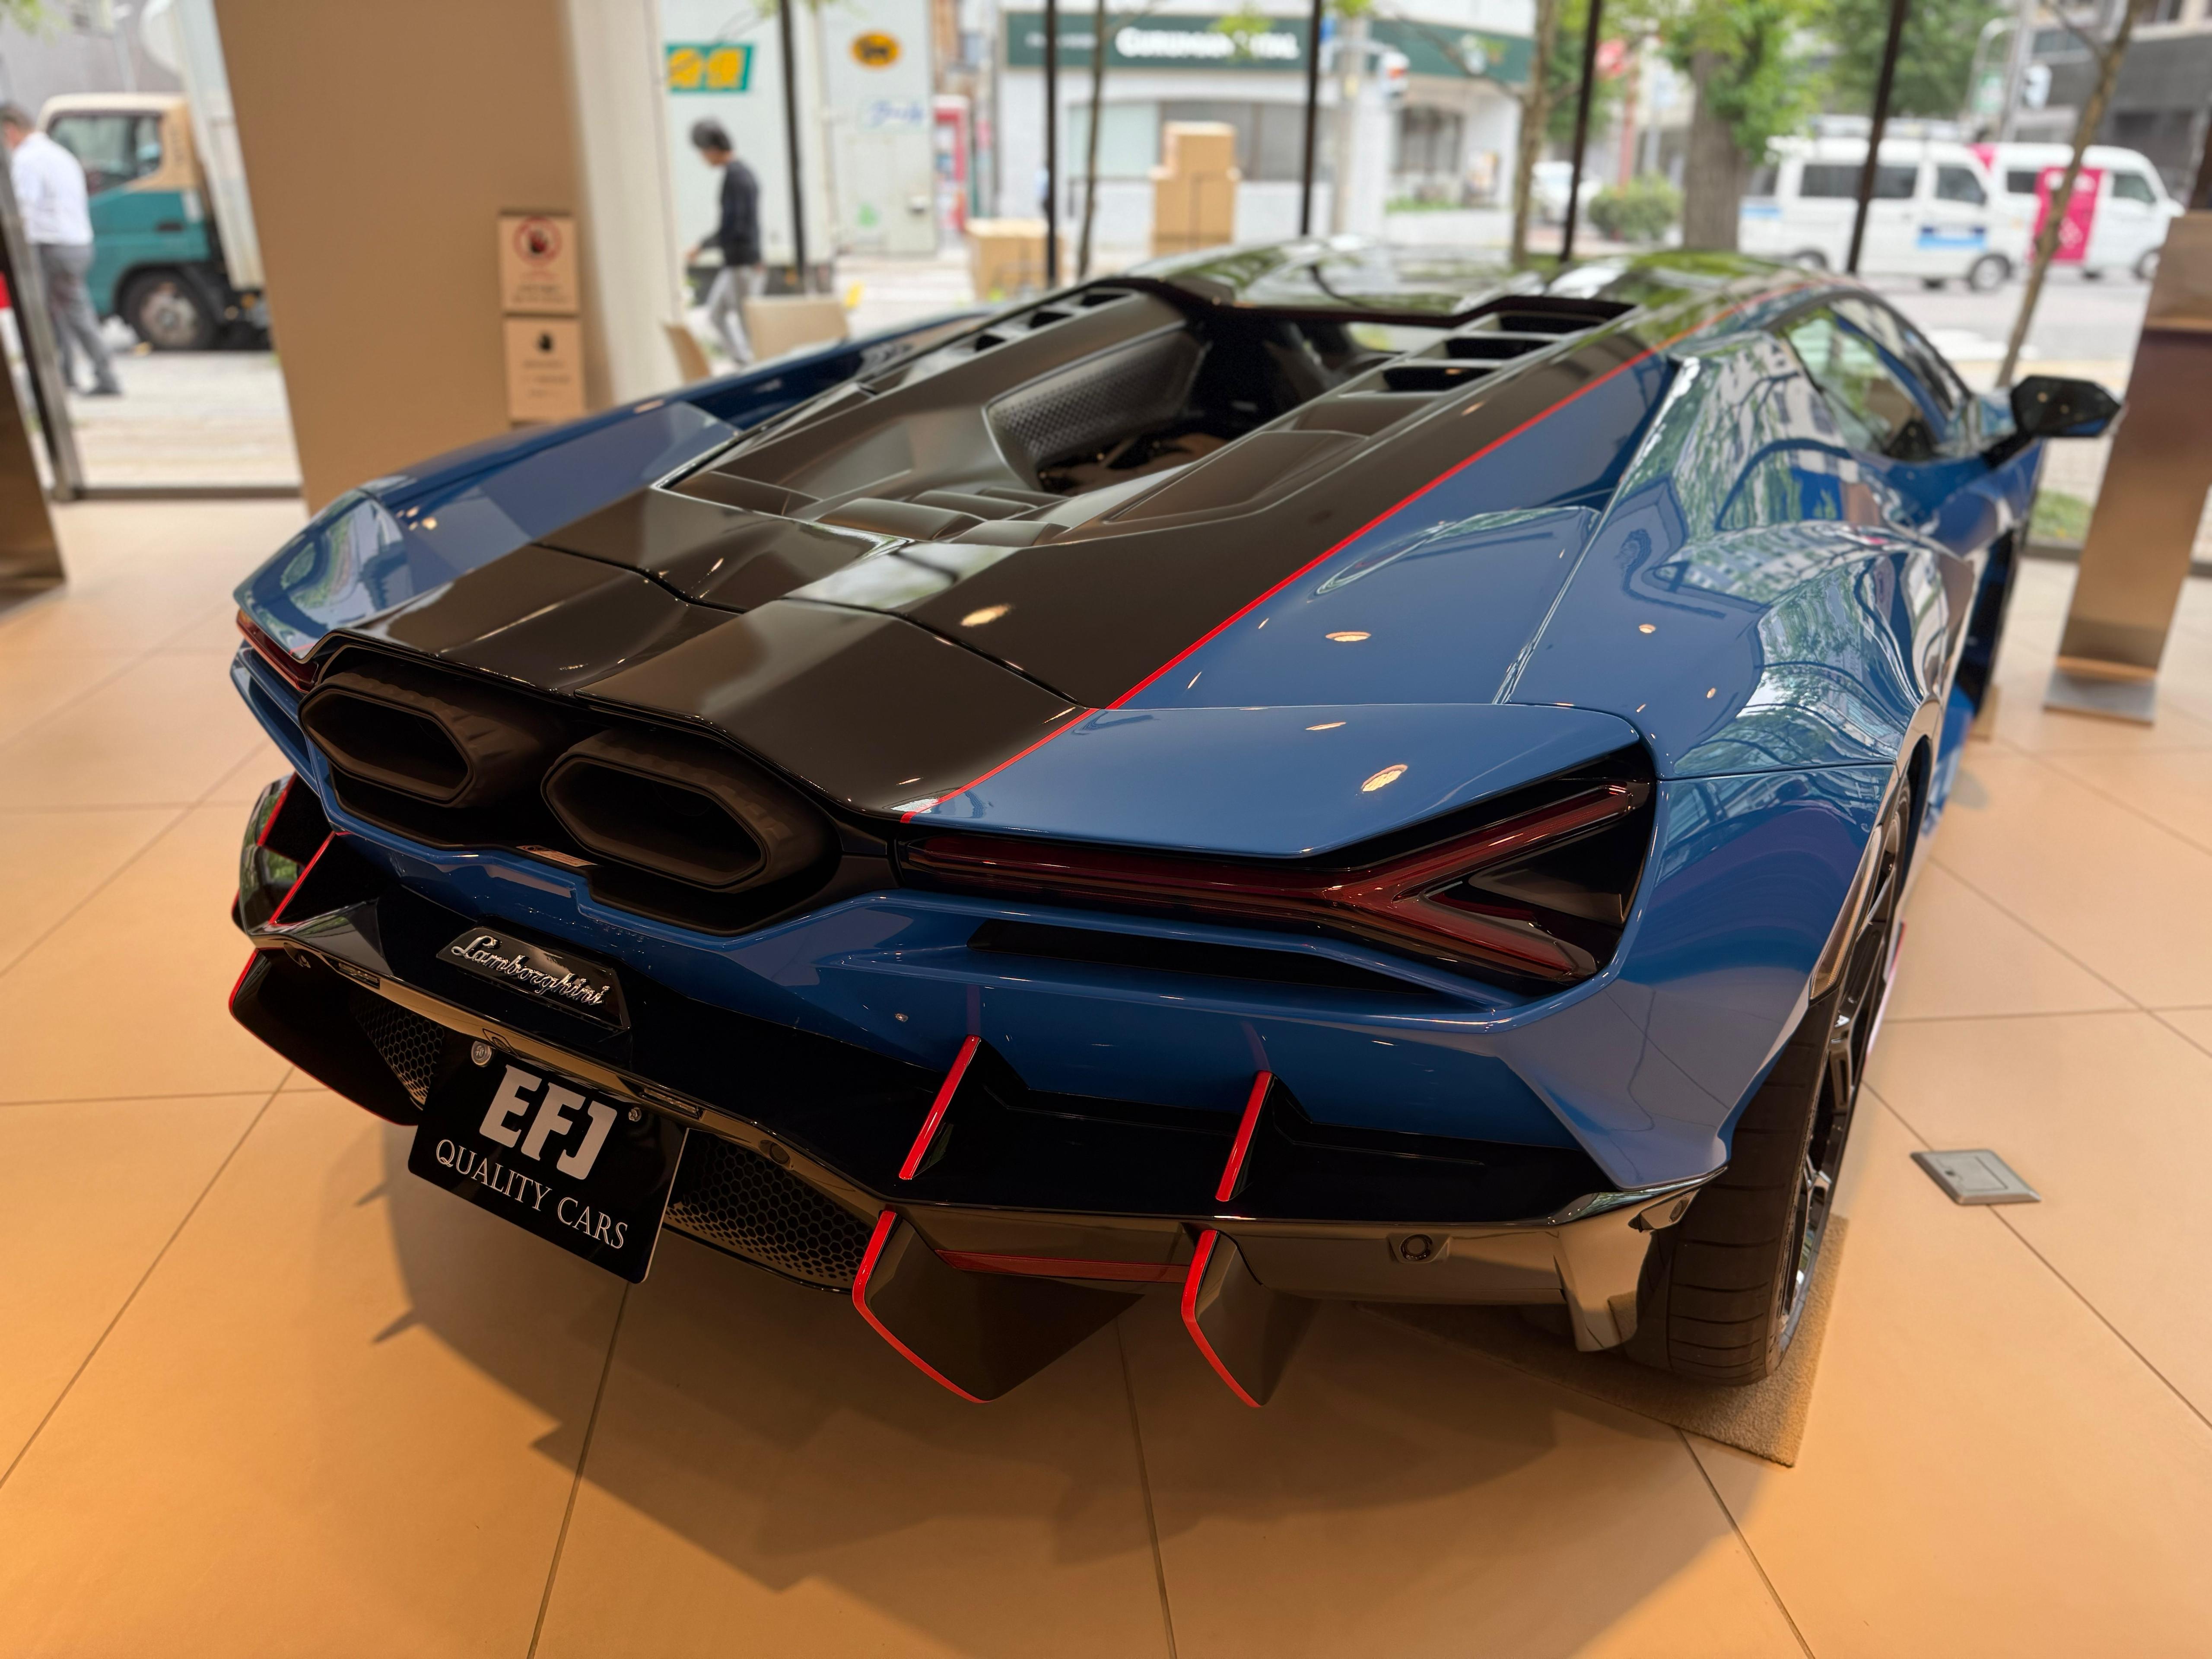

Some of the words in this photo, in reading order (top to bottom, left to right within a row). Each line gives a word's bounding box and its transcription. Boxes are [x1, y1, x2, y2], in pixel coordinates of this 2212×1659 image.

[451, 935, 610, 1006] Lamborghini
[479, 1064, 617, 1180] EFJ
[436, 1139, 553, 1211] QUALITY
[557, 1197, 628, 1249] CARS
